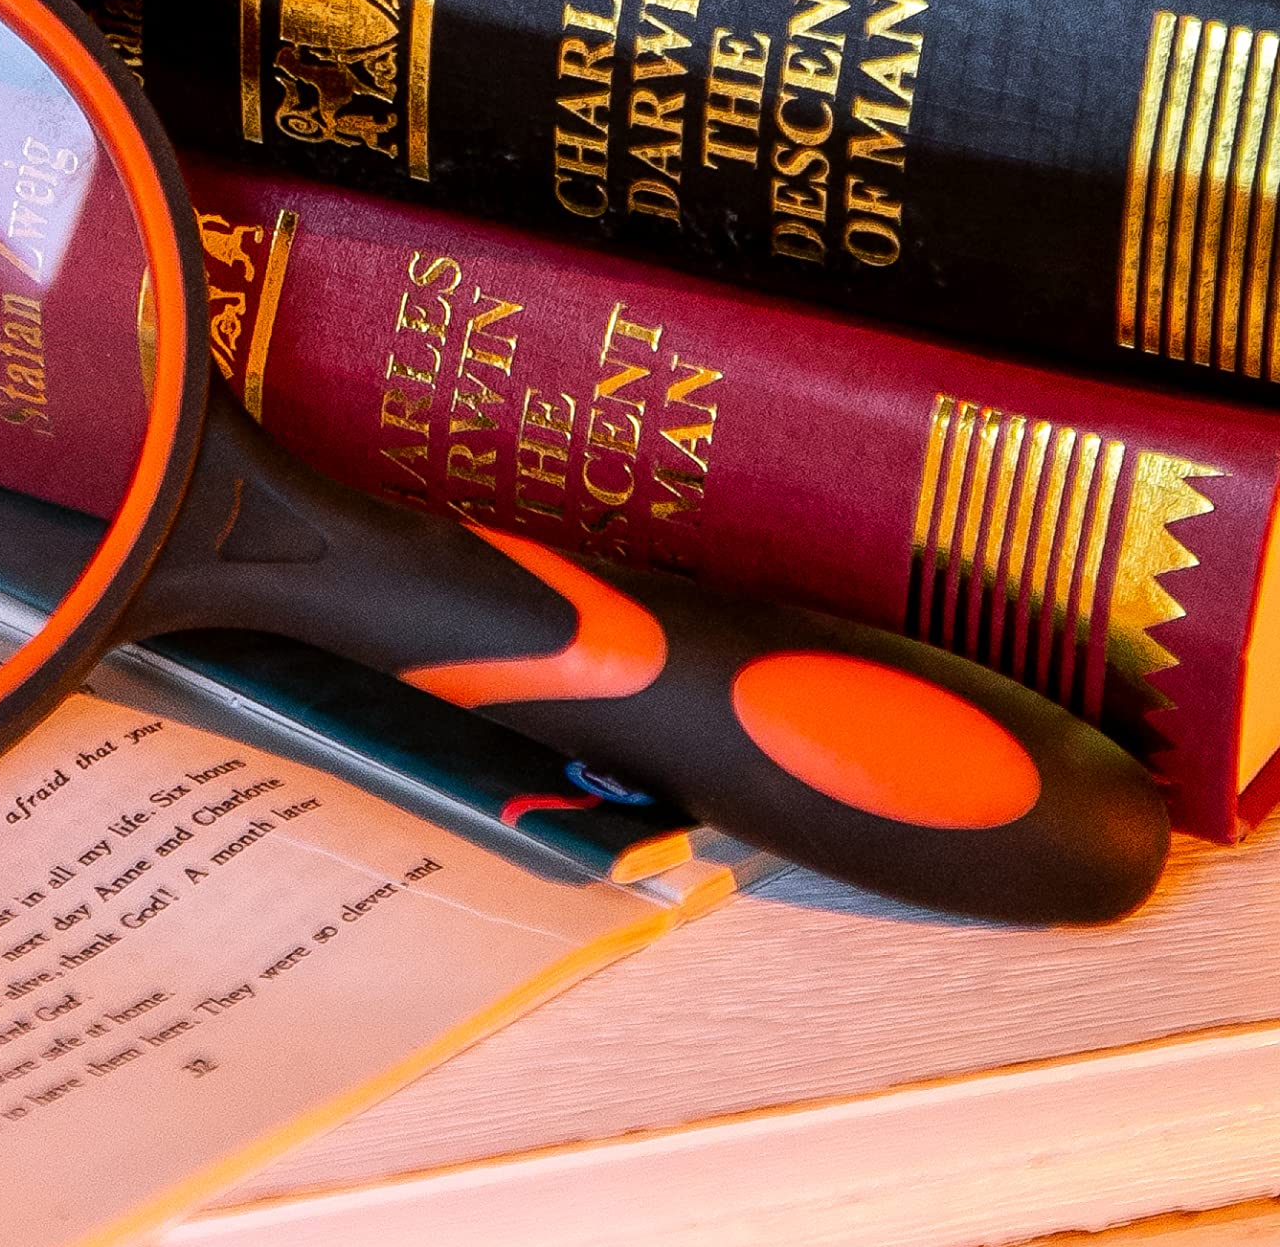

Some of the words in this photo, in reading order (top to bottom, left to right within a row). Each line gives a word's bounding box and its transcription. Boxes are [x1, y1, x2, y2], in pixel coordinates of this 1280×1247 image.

[704, 27, 771, 170] THE
[843, 177, 905, 267] OF
[379, 251, 462, 491] ARLES
[575, 302, 662, 535] SCENT
[650, 354, 723, 521] MAN
[5, 770, 70, 827] afraid
[75, 740, 118, 771] that
[124, 719, 164, 744] your
[15, 889, 46, 909] in
[47, 866, 76, 890] all
[79, 838, 111, 868] my
[149, 784, 190, 808] Six
[186, 756, 247, 786] hours
[1, 932, 50, 961] next
[53, 903, 93, 932] day
[94, 860, 153, 904] Anne
[156, 827, 195, 858] and
[191, 776, 286, 827] Charlotte
[60, 932, 122, 973] thank
[120, 887, 181, 930] God!
[183, 866, 209, 885] A
[209, 820, 276, 866] month
[279, 795, 322, 823] later
[40, 1034, 86, 1062] safe
[86, 1045, 141, 1078] them
[193, 981, 257, 1018] They
[259, 944, 314, 983] were
[312, 924, 339, 944] so
